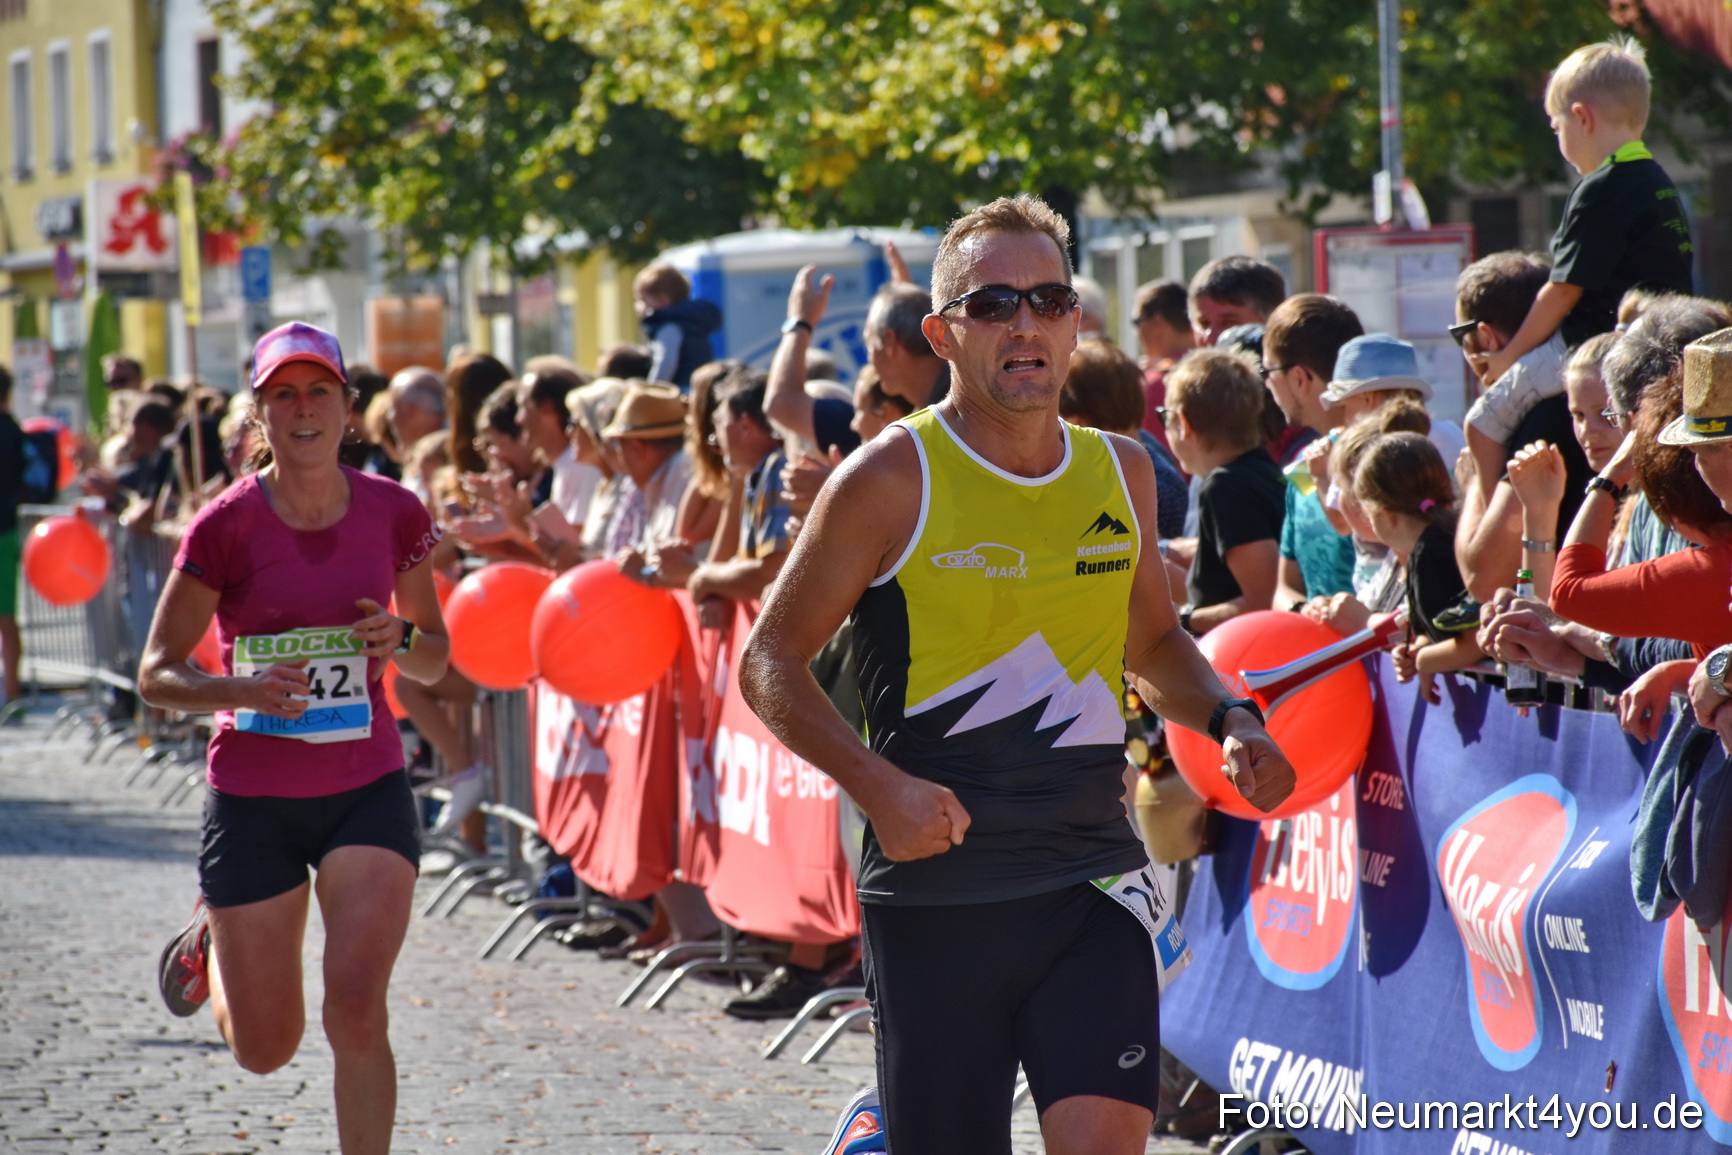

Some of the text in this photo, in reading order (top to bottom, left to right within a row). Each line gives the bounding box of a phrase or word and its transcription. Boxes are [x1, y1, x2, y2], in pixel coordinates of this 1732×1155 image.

[1075, 558, 1131, 576] Runners
[1077, 540, 1132, 558] Kettenbach
[985, 567, 1029, 579] MARX
[1363, 770, 1404, 810] STORE
[1262, 898, 1313, 936] SPORTS
[1543, 914, 1590, 953] ONLINE
[1566, 998, 1604, 1040] MOBILE
[1229, 1037, 1282, 1105] GET
